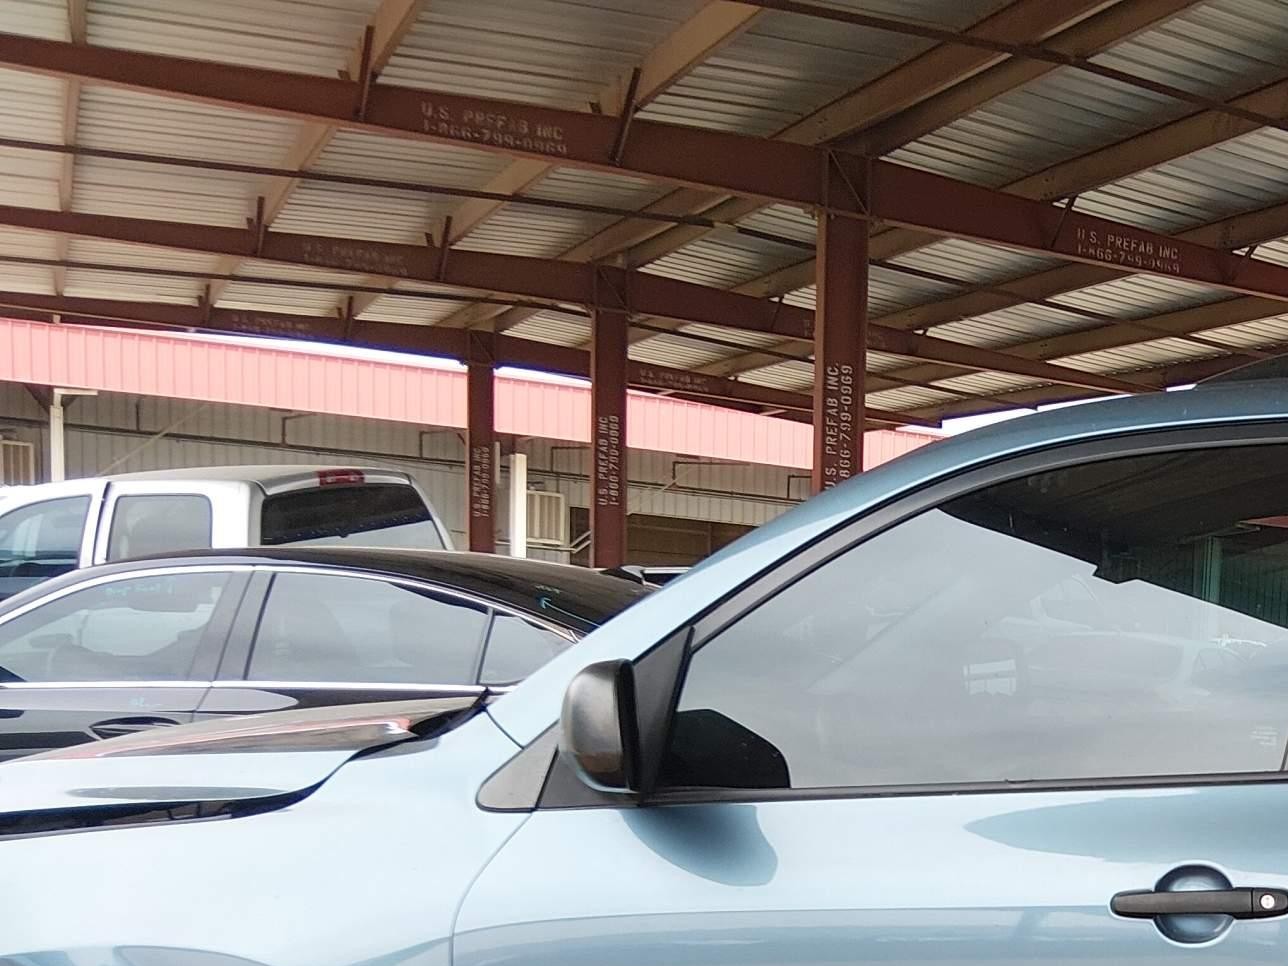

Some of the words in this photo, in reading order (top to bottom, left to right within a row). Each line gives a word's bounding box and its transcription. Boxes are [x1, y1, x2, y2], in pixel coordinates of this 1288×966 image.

[1107, 234, 1153, 255] PREFAB
[826, 362, 839, 390] INC.
[825, 398, 839, 455] PREFAB
[839, 365, 853, 479] 866-799-0969
[598, 438, 609, 480] PREFAB
